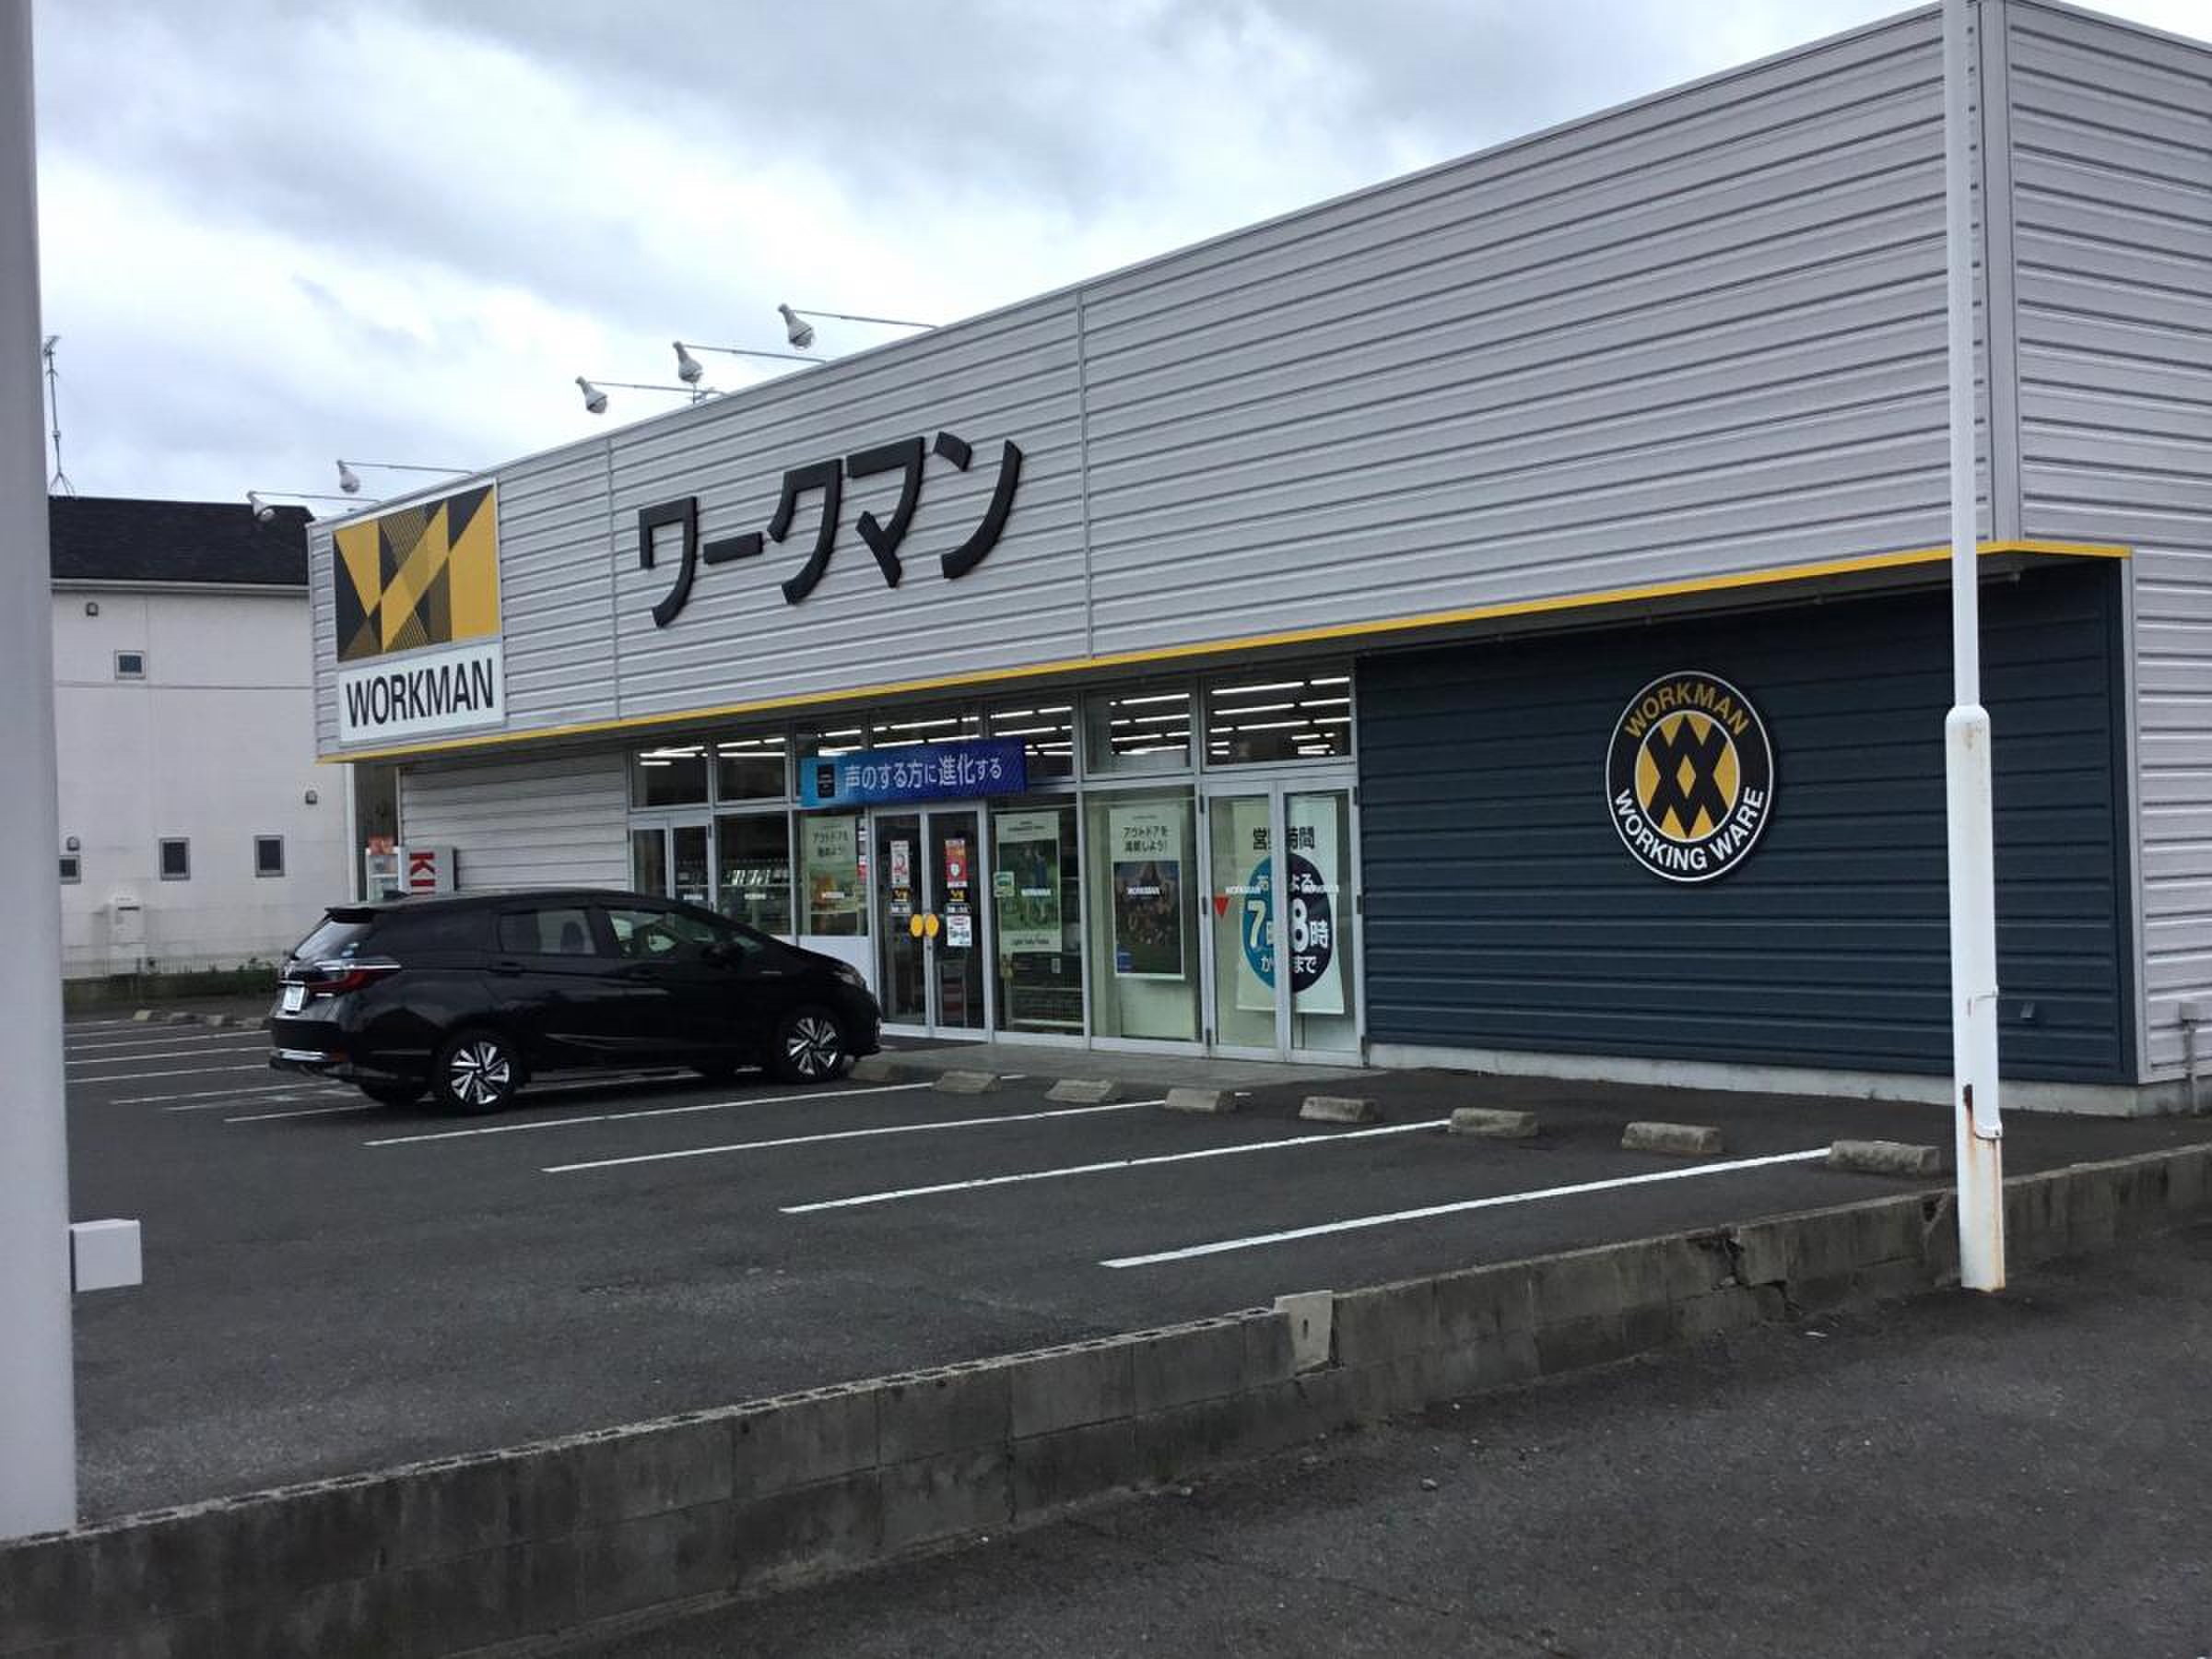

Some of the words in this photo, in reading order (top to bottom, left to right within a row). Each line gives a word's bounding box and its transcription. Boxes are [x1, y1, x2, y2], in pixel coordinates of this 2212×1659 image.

[639, 431, 1022, 628] ワークマン
[347, 658, 494, 728] WORKMAN
[1624, 682, 1749, 738] WORKMAN
[844, 752, 1003, 791] 声のする方に進化する
[1615, 788, 1709, 871] WORKING
[1709, 786, 1764, 861] WARE
